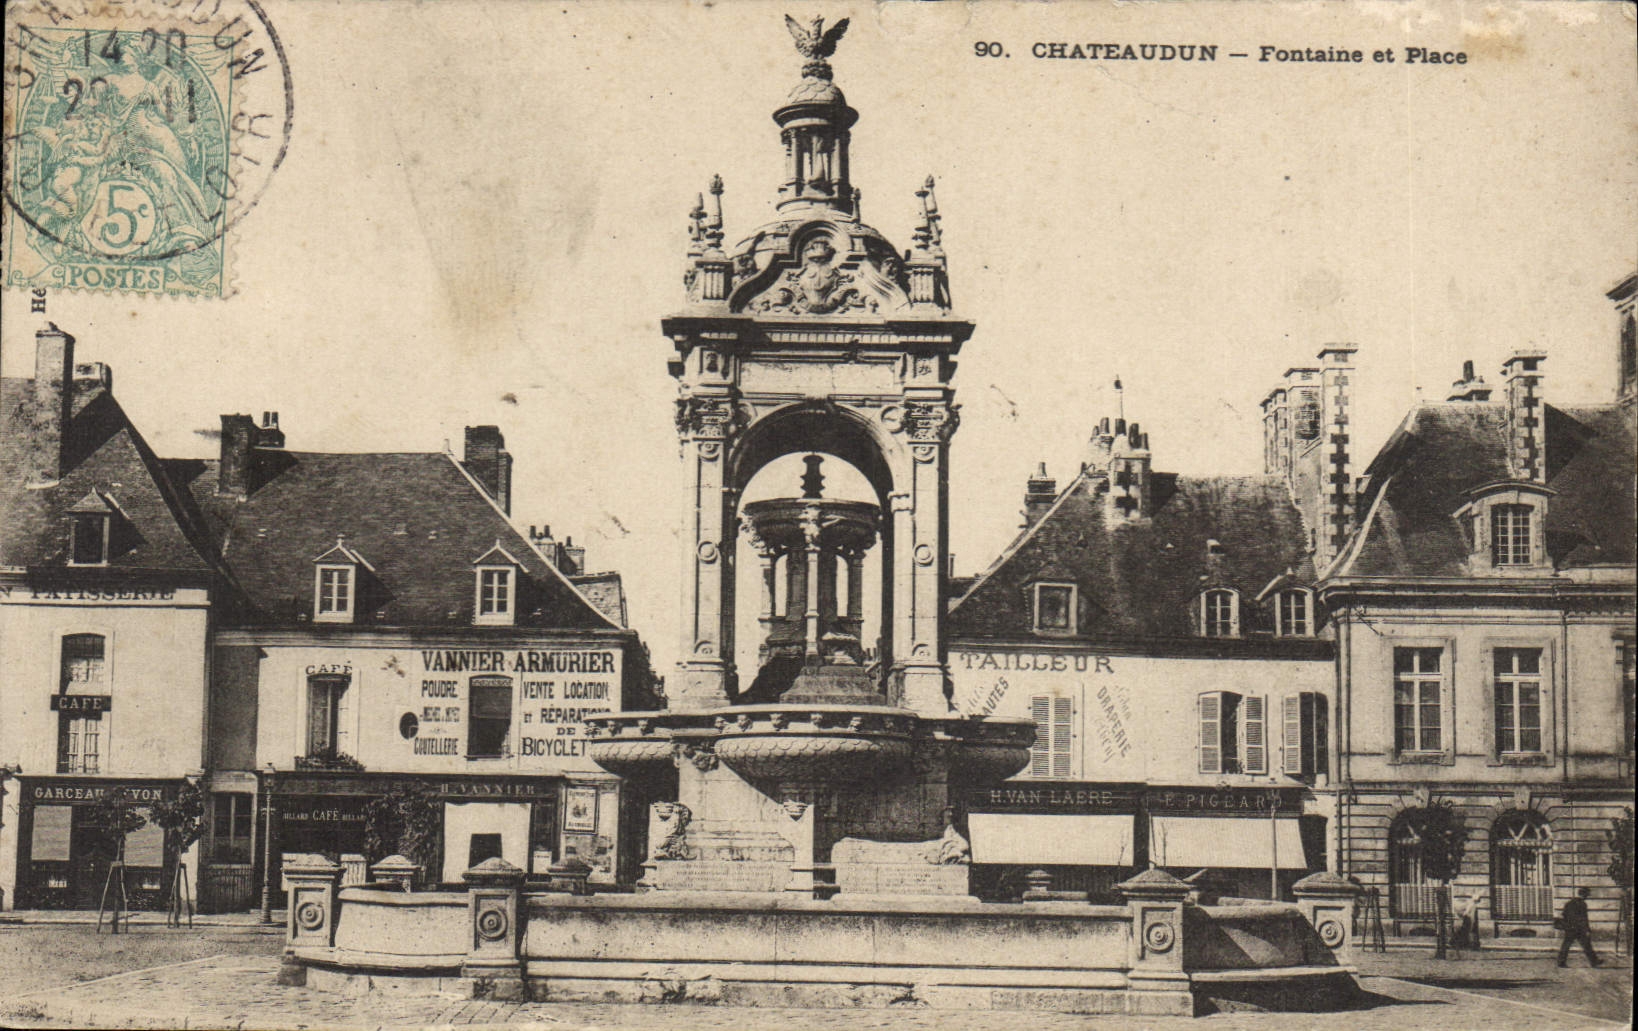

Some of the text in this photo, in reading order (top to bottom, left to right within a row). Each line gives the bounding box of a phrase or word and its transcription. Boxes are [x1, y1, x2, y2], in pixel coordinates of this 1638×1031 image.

[67, 267, 160, 289] POSTES
[422, 651, 615, 673] VANNIER ARMURIER
[960, 652, 1115, 674] TAILLEUR
[421, 680, 458, 698] POUDRE
[523, 681, 554, 699] VENTE
[556, 727, 576, 735] DE
[521, 737, 596, 756] BICYCLET
[1050, 791, 1112, 805] LAERE
